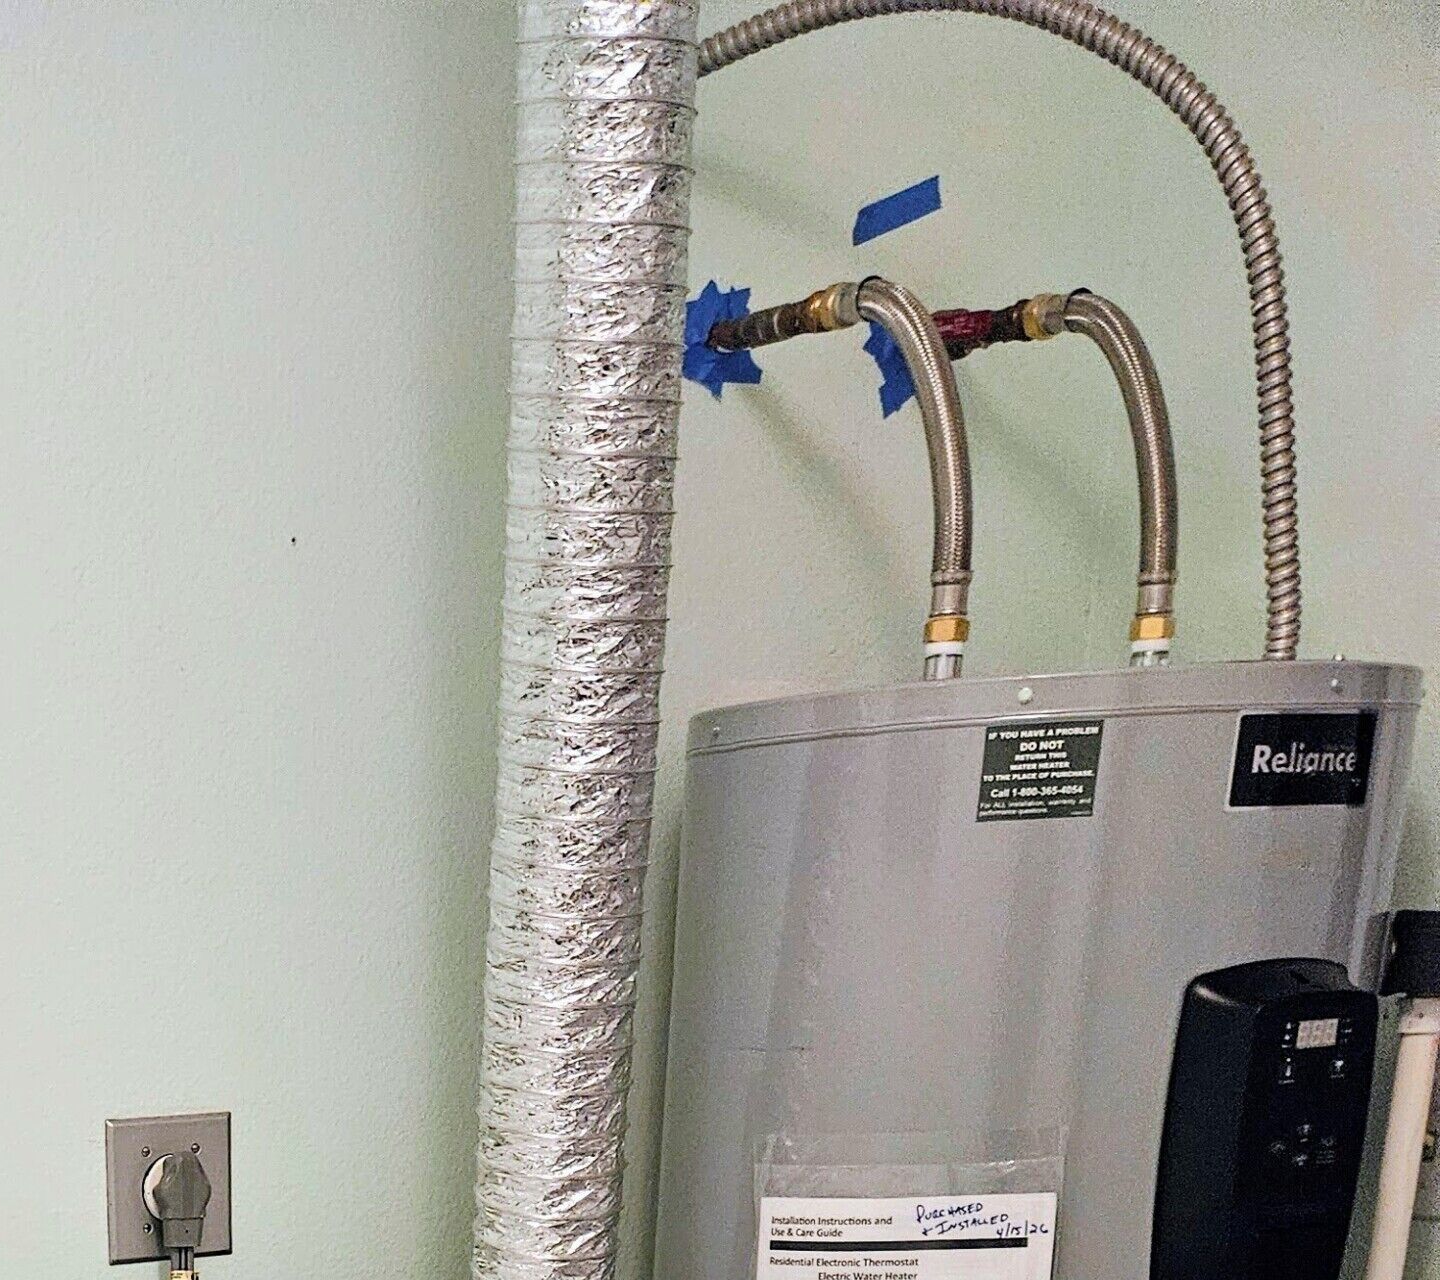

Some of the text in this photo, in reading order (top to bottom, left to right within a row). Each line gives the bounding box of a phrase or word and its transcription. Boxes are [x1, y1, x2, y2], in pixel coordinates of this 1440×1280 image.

[1000, 731, 1019, 739] YOU
[1020, 729, 1045, 738] HAVE
[1055, 727, 1099, 737] PROBLEM
[1020, 740, 1065, 752] DO NOT
[1251, 742, 1357, 774] Reliance
[990, 788, 1010, 798] Call
[916, 1203, 984, 1224] PURCHASED
[771, 1216, 893, 1226] Installation Instructions and
[935, 1213, 1009, 1235] INSTALLED
[771, 1228, 844, 1237] Use & Care Guide
[770, 1257, 919, 1267] Residential Electronic Thermostat
[818, 1272, 918, 1280] Electric Water Heater
